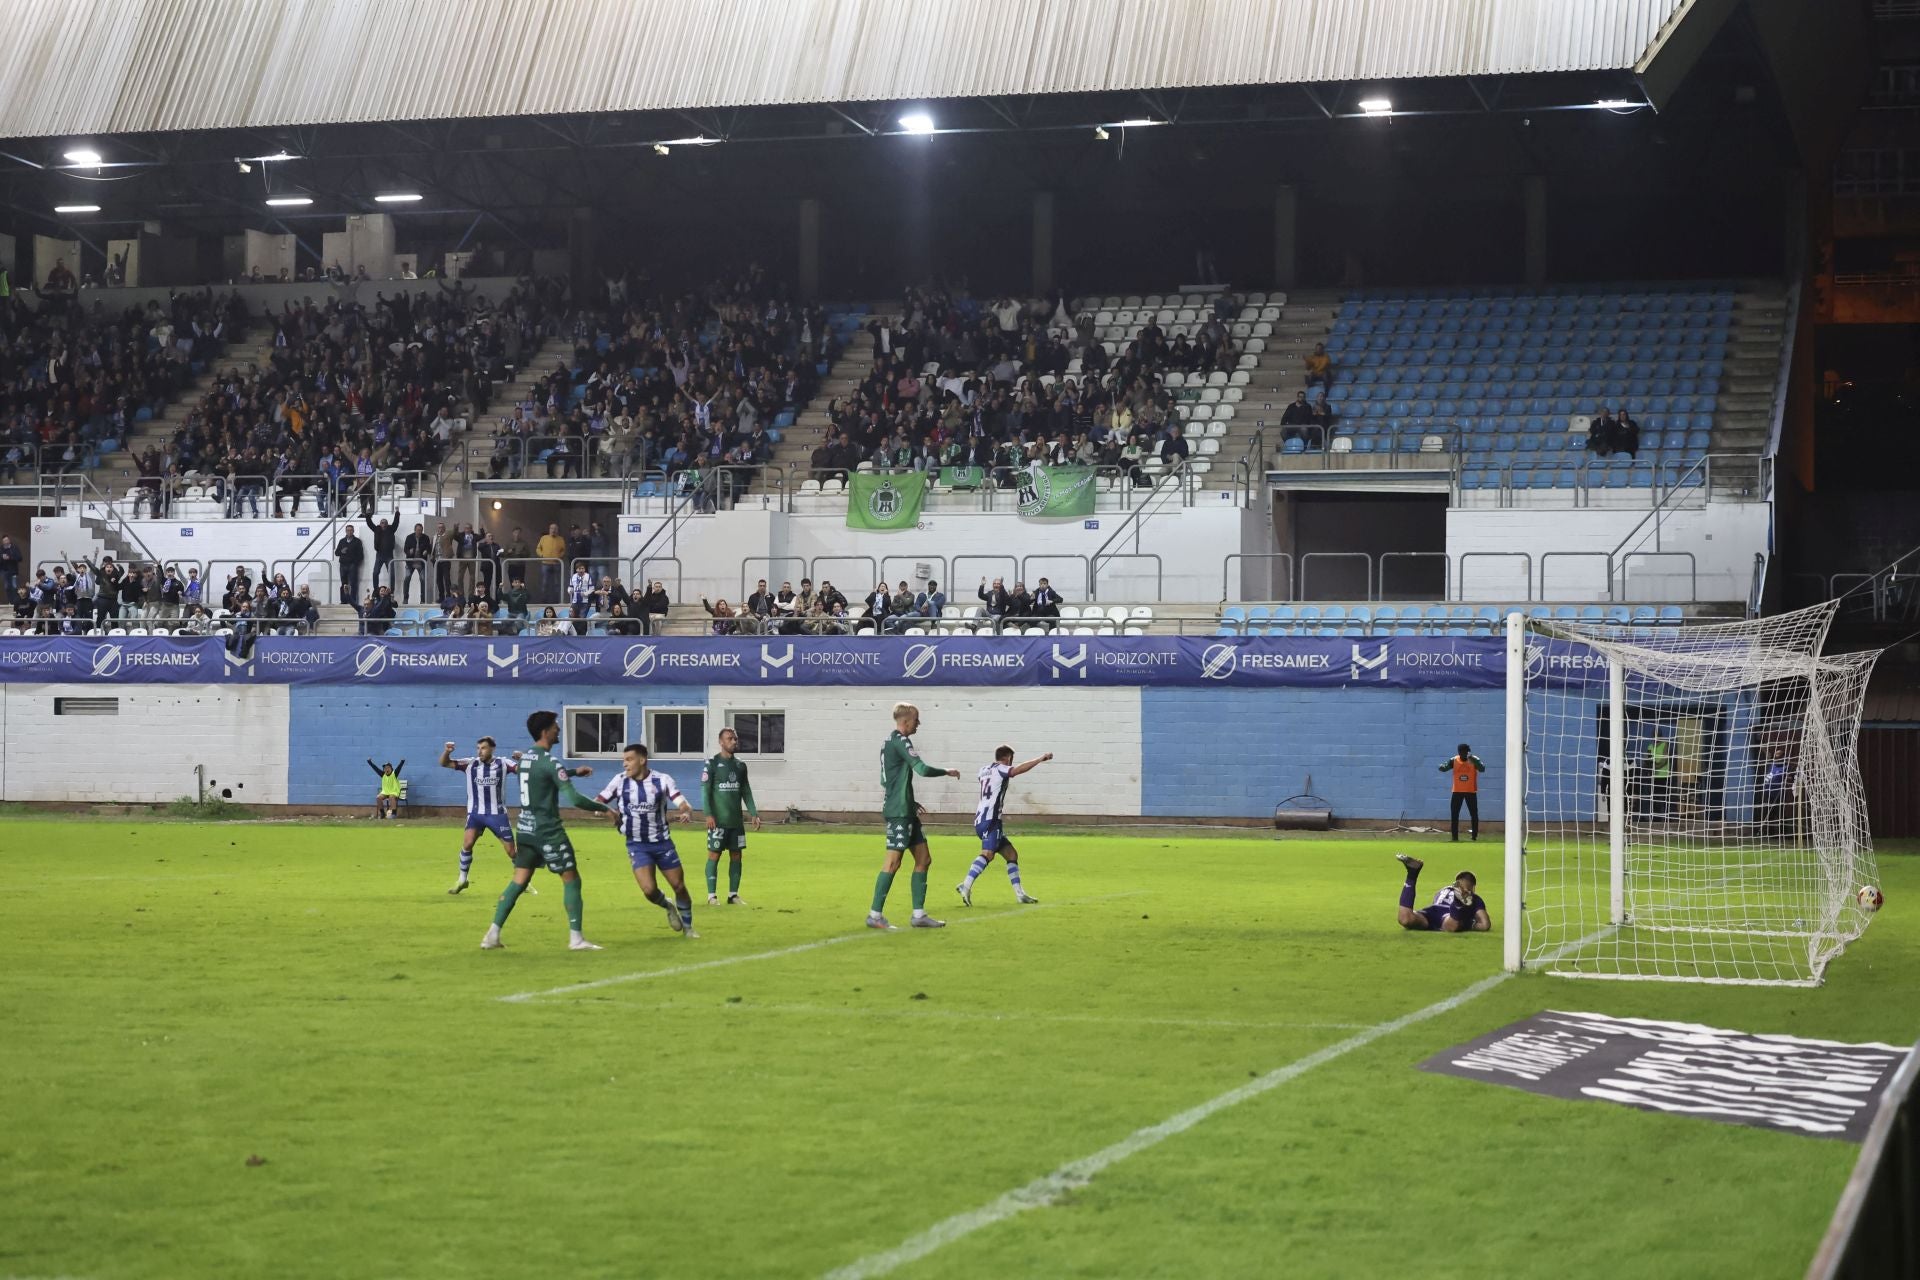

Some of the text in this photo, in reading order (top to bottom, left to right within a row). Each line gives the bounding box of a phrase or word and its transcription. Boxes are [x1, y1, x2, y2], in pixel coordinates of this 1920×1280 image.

[2, 652, 72, 664] HORIZONTE
[126, 653, 200, 666] FRESAMEX
[261, 652, 335, 664] HORIZONTE
[391, 653, 468, 666] FRESAMEX
[526, 652, 601, 665] HORIZONTE
[660, 654, 741, 667] FRESAMEX
[801, 652, 881, 665] HORIZONTE
[942, 654, 1025, 667] FRESAMEX
[1095, 652, 1177, 665] HORIZONTE
[1242, 654, 1329, 668] FRESAMEX
[1396, 653, 1482, 667] HORIZONTE
[520, 772, 530, 807] 5
[980, 778, 993, 800] 14
[712, 828, 725, 840] 22
